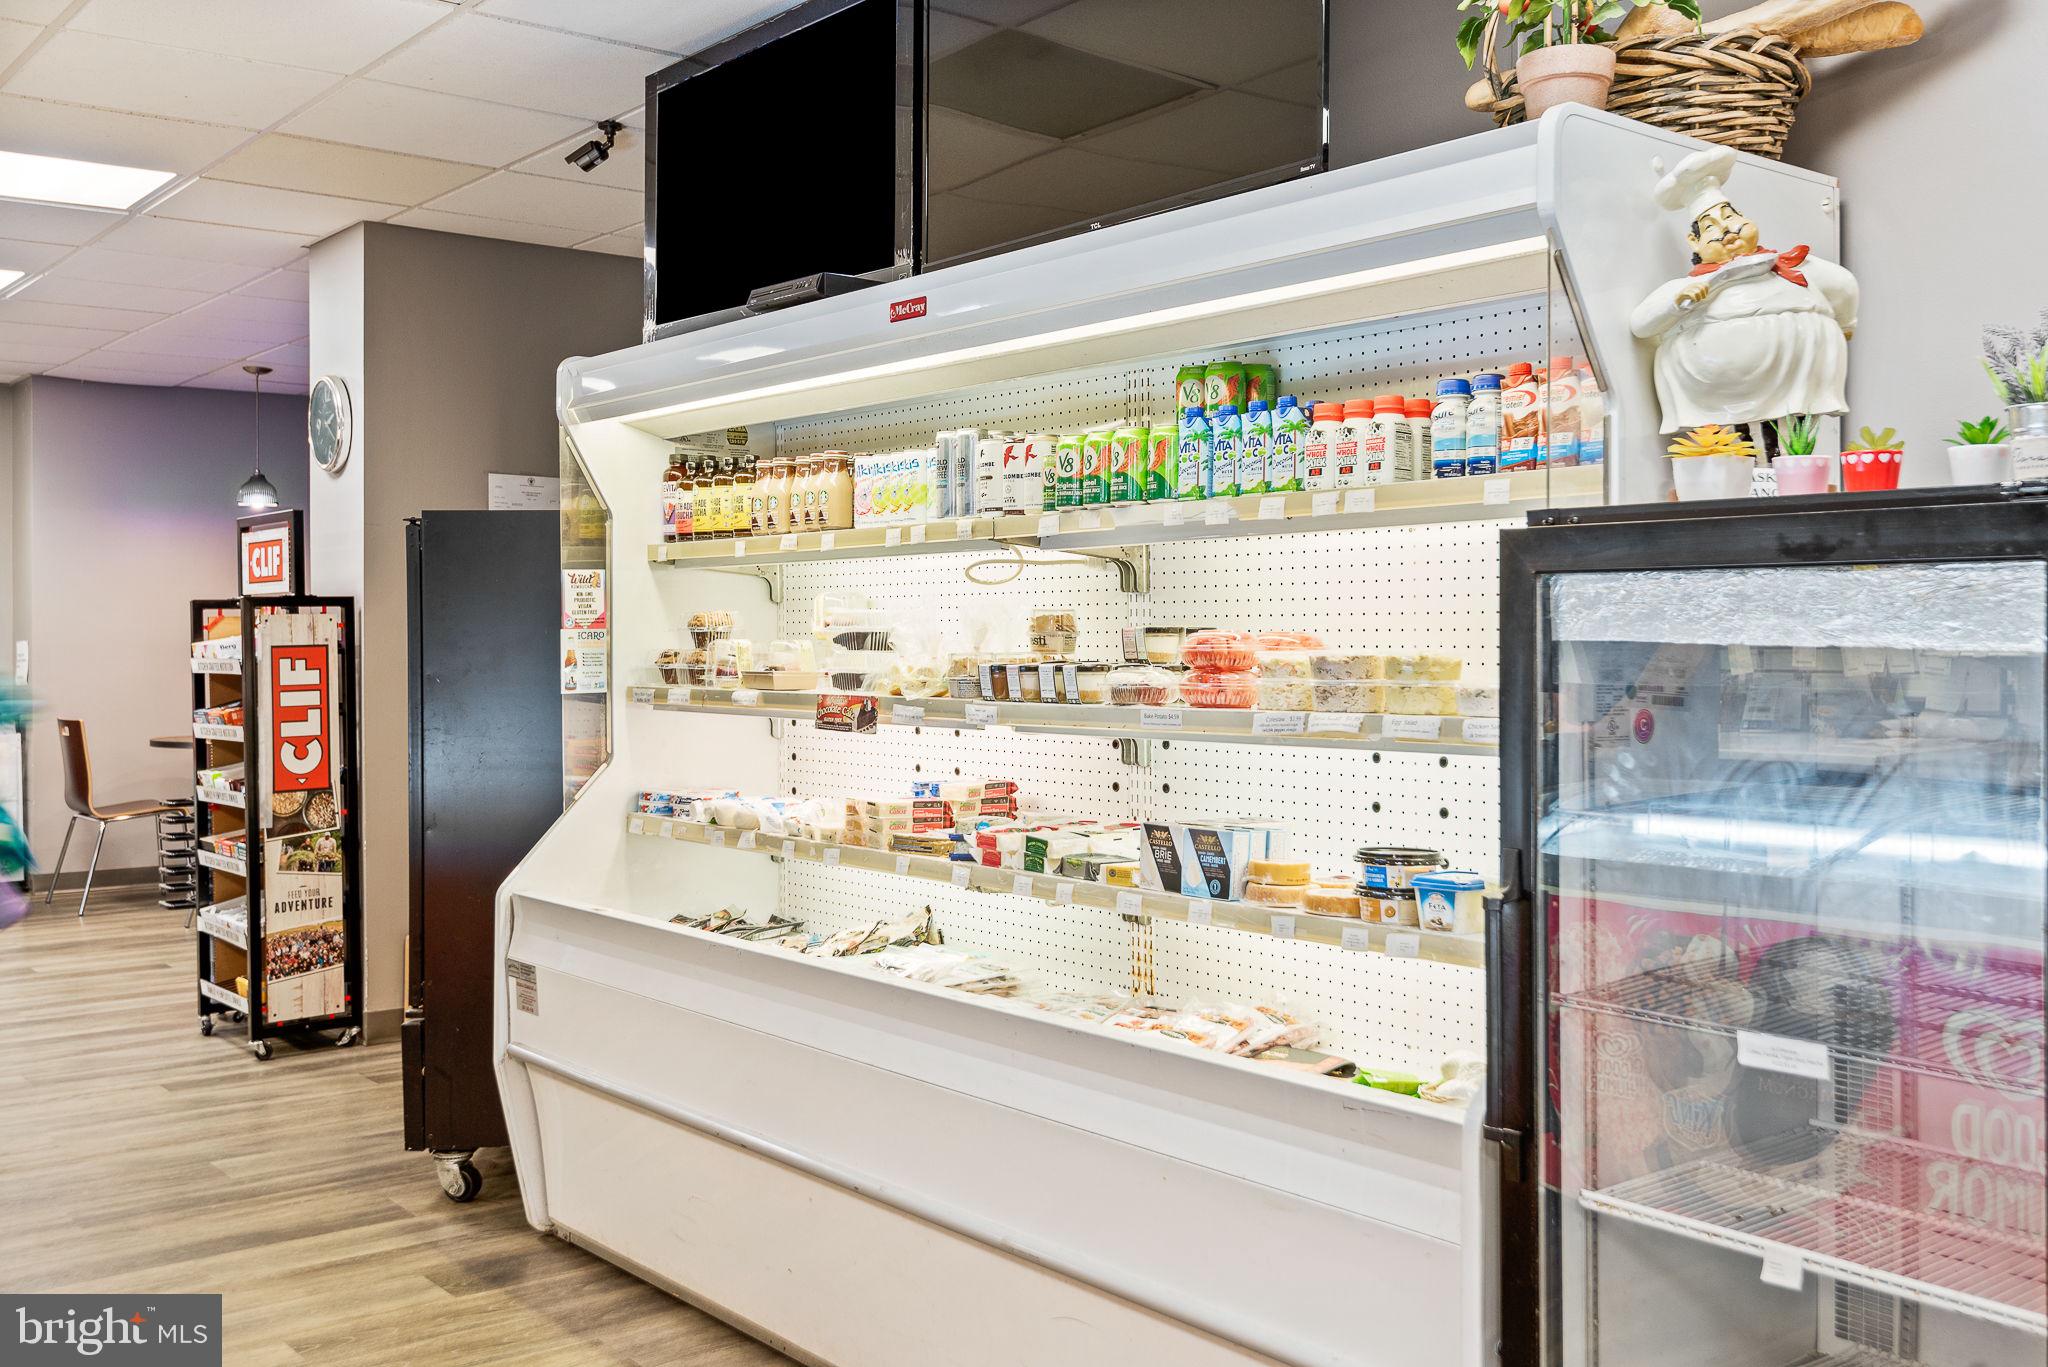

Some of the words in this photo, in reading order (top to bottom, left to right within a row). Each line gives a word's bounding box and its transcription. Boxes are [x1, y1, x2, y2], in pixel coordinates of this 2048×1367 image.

[1090, 222, 1102, 230] TCL
[895, 302, 926, 316] McCray
[1183, 382, 1200, 403] V8
[1242, 435, 1263, 449] VITA
[1273, 432, 1294, 446] VITA
[1336, 448, 1357, 456] WHOLE
[1366, 443, 1385, 452] WHOLE
[1306, 450, 1327, 458] WHOLE
[1366, 451, 1386, 463] MILK
[1059, 451, 1074, 473] V8
[1306, 457, 1327, 468] MILK
[1336, 455, 1358, 467] MILK
[1044, 468, 1056, 484] V8
[251, 544, 281, 578] CLIF
[568, 572, 595, 584] Wild
[280, 657, 323, 775] CLIF
[1149, 838, 1173, 847] CASTELLO
[1194, 844, 1222, 852] CASTELLO
[1154, 849, 1173, 860] BRIE
[1200, 855, 1227, 865] CAMEMBERT
[287, 889, 301, 899] FEED
[274, 896, 334, 914] ADVENTURE
[1428, 902, 1446, 911] FETA
